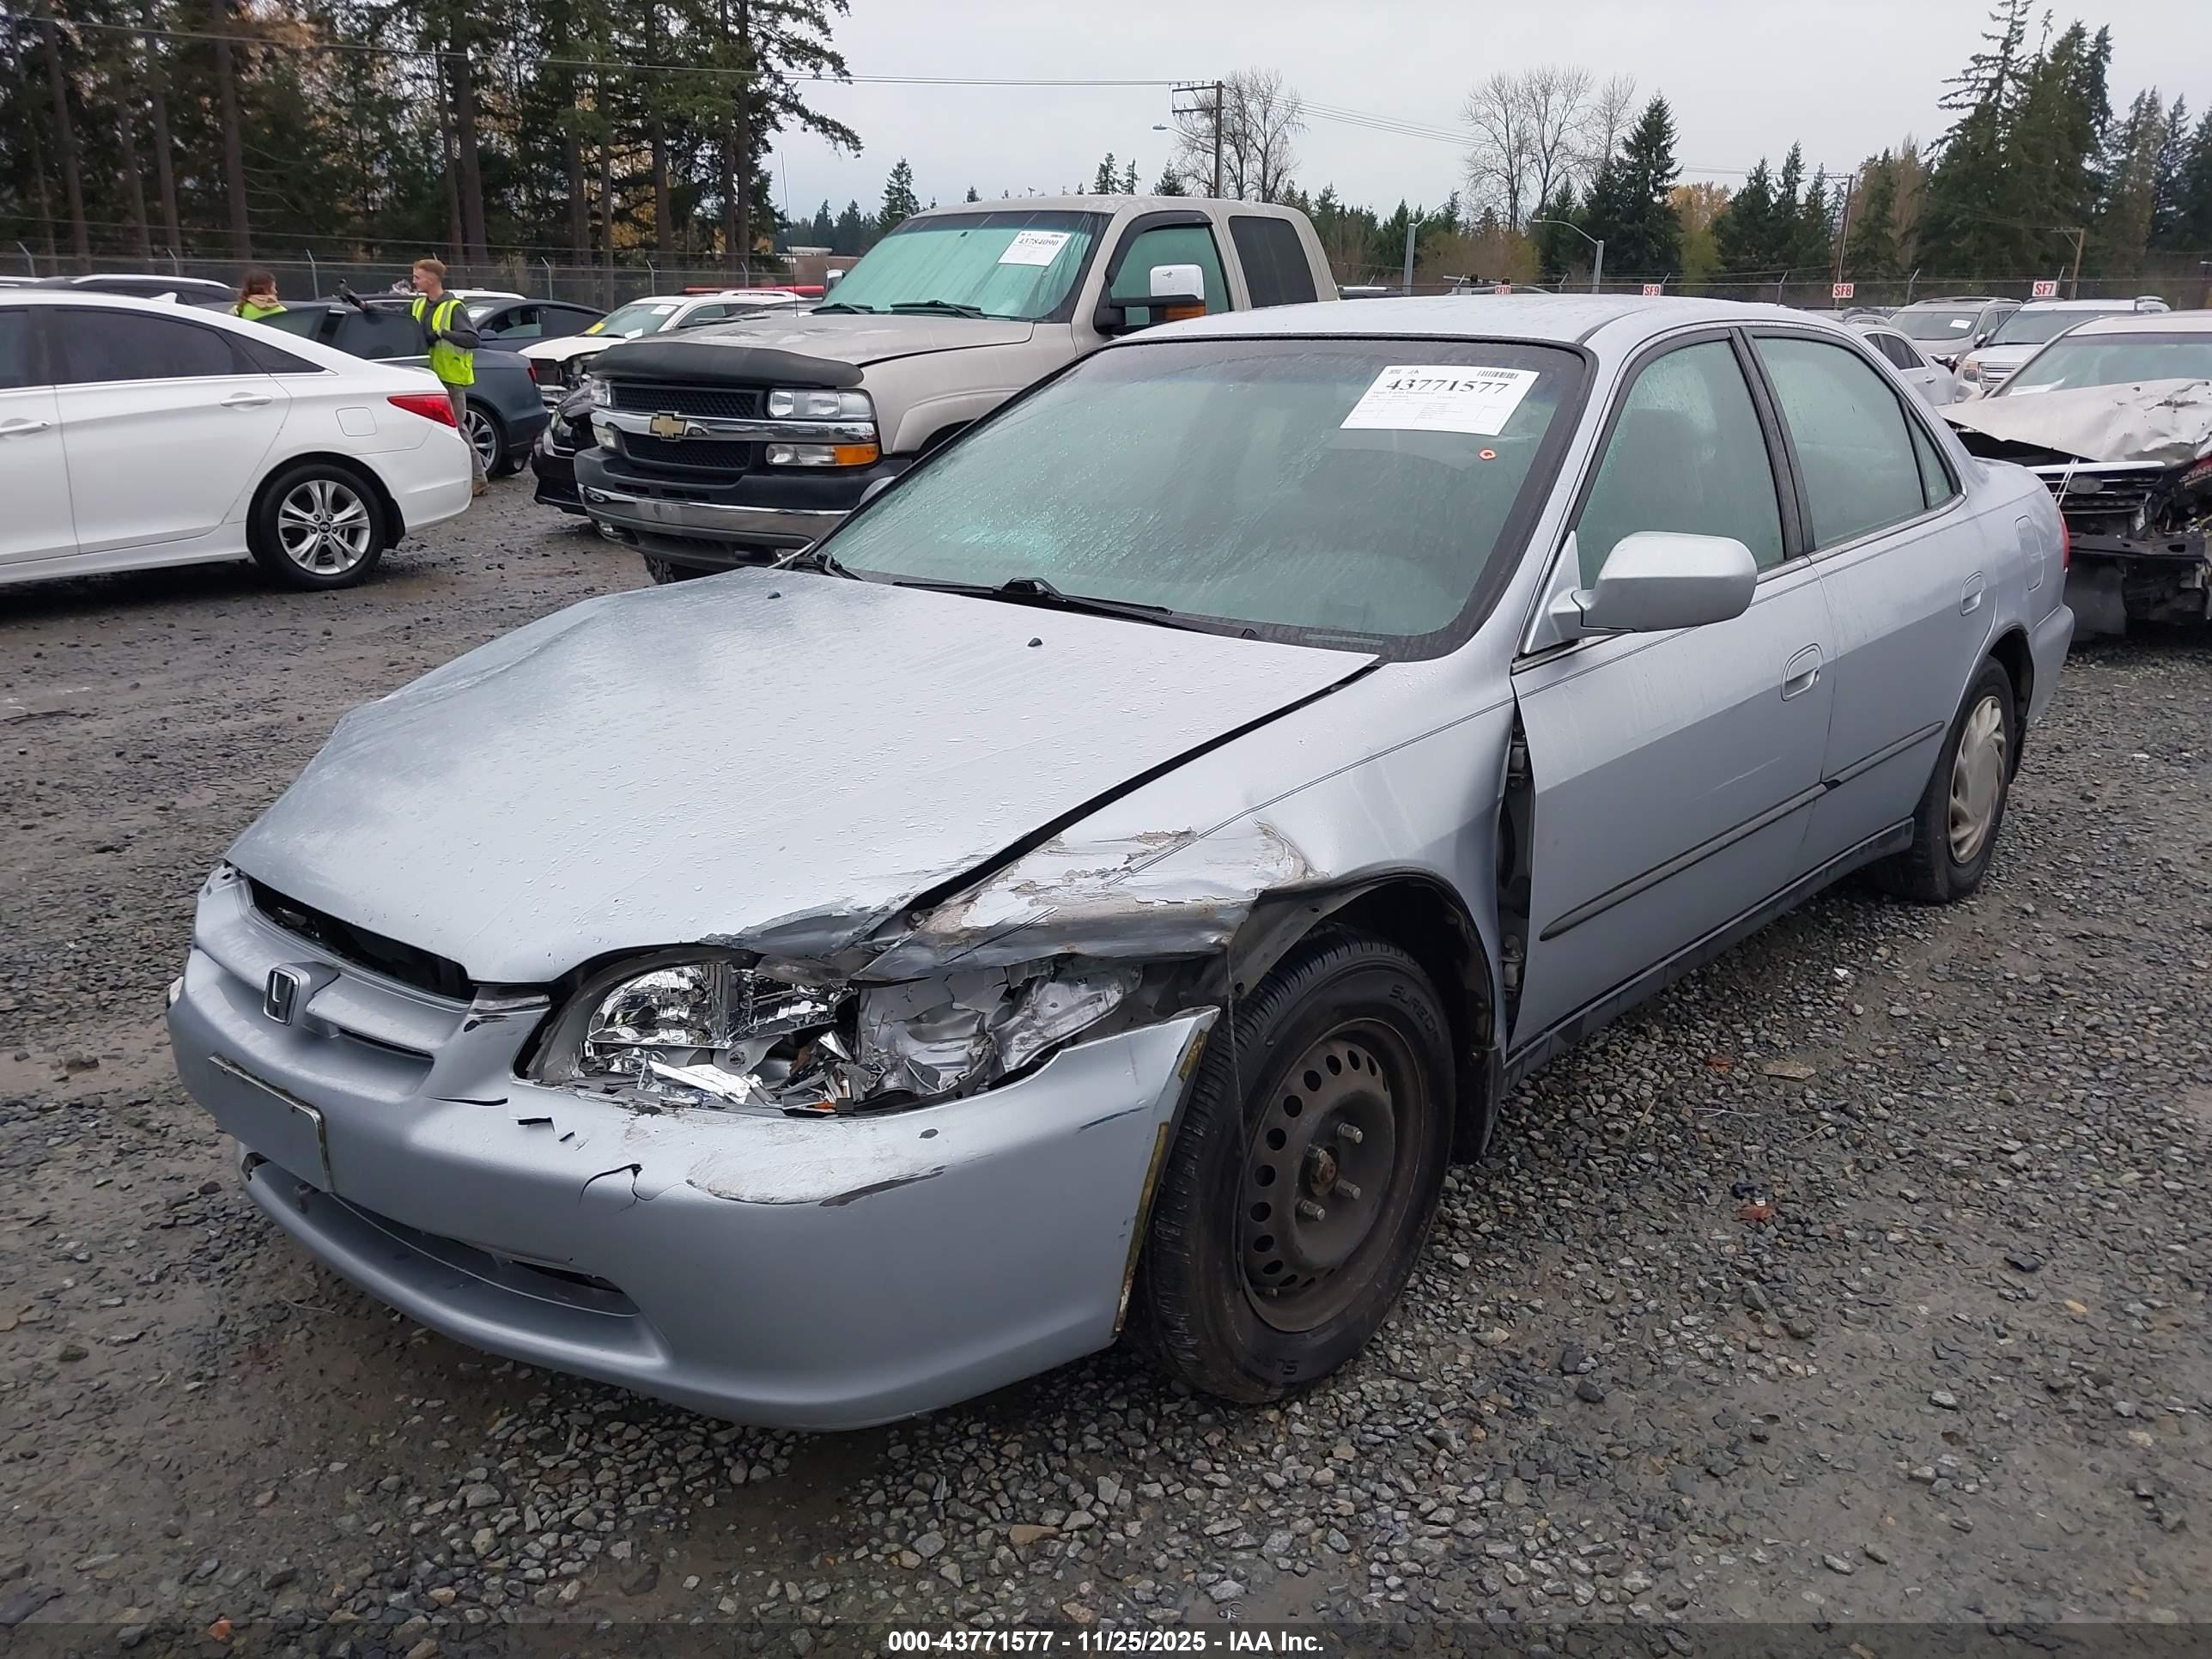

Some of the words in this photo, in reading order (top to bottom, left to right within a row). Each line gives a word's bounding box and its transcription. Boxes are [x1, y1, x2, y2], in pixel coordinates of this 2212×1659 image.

[1644, 285, 1660, 296] SF9
[1834, 284, 1851, 296] SF8
[2035, 283, 2054, 295] SF7
[1386, 379, 1510, 394] 43771577
